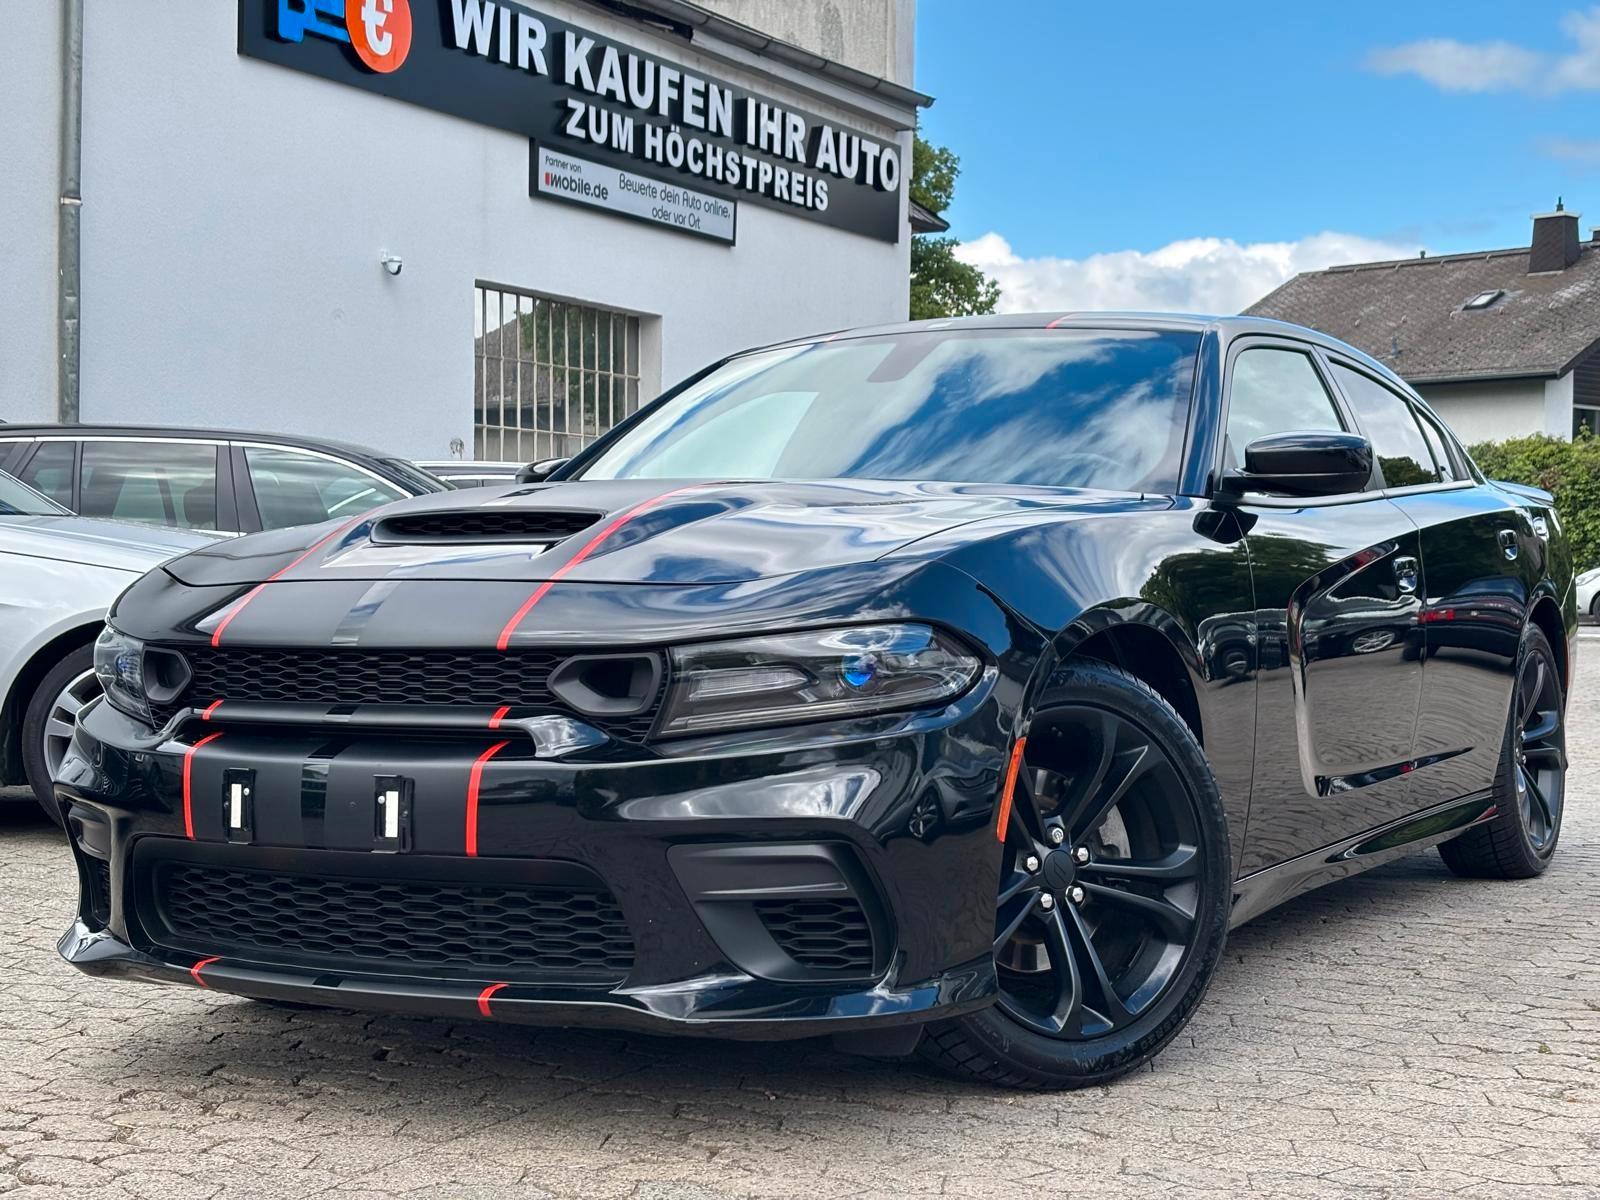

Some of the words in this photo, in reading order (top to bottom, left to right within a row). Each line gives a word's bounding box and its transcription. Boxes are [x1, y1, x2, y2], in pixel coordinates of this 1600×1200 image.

[451, 0, 549, 76] WIR
[564, 30, 734, 138] KAUFEN
[747, 97, 807, 164] IHR
[815, 125, 900, 192] AUTO
[545, 155, 569, 170] Partner
[570, 164, 582, 173] von
[565, 98, 634, 154] ZUM
[644, 124, 829, 212] HÖCHSTPREIS
[550, 174, 608, 200] mobile.de
[618, 173, 658, 198] Bewerte
[659, 186, 681, 206] dein
[682, 190, 702, 211] Auto
[651, 206, 672, 221] oder
[673, 212, 686, 225] vor
[688, 214, 701, 230] Ort
